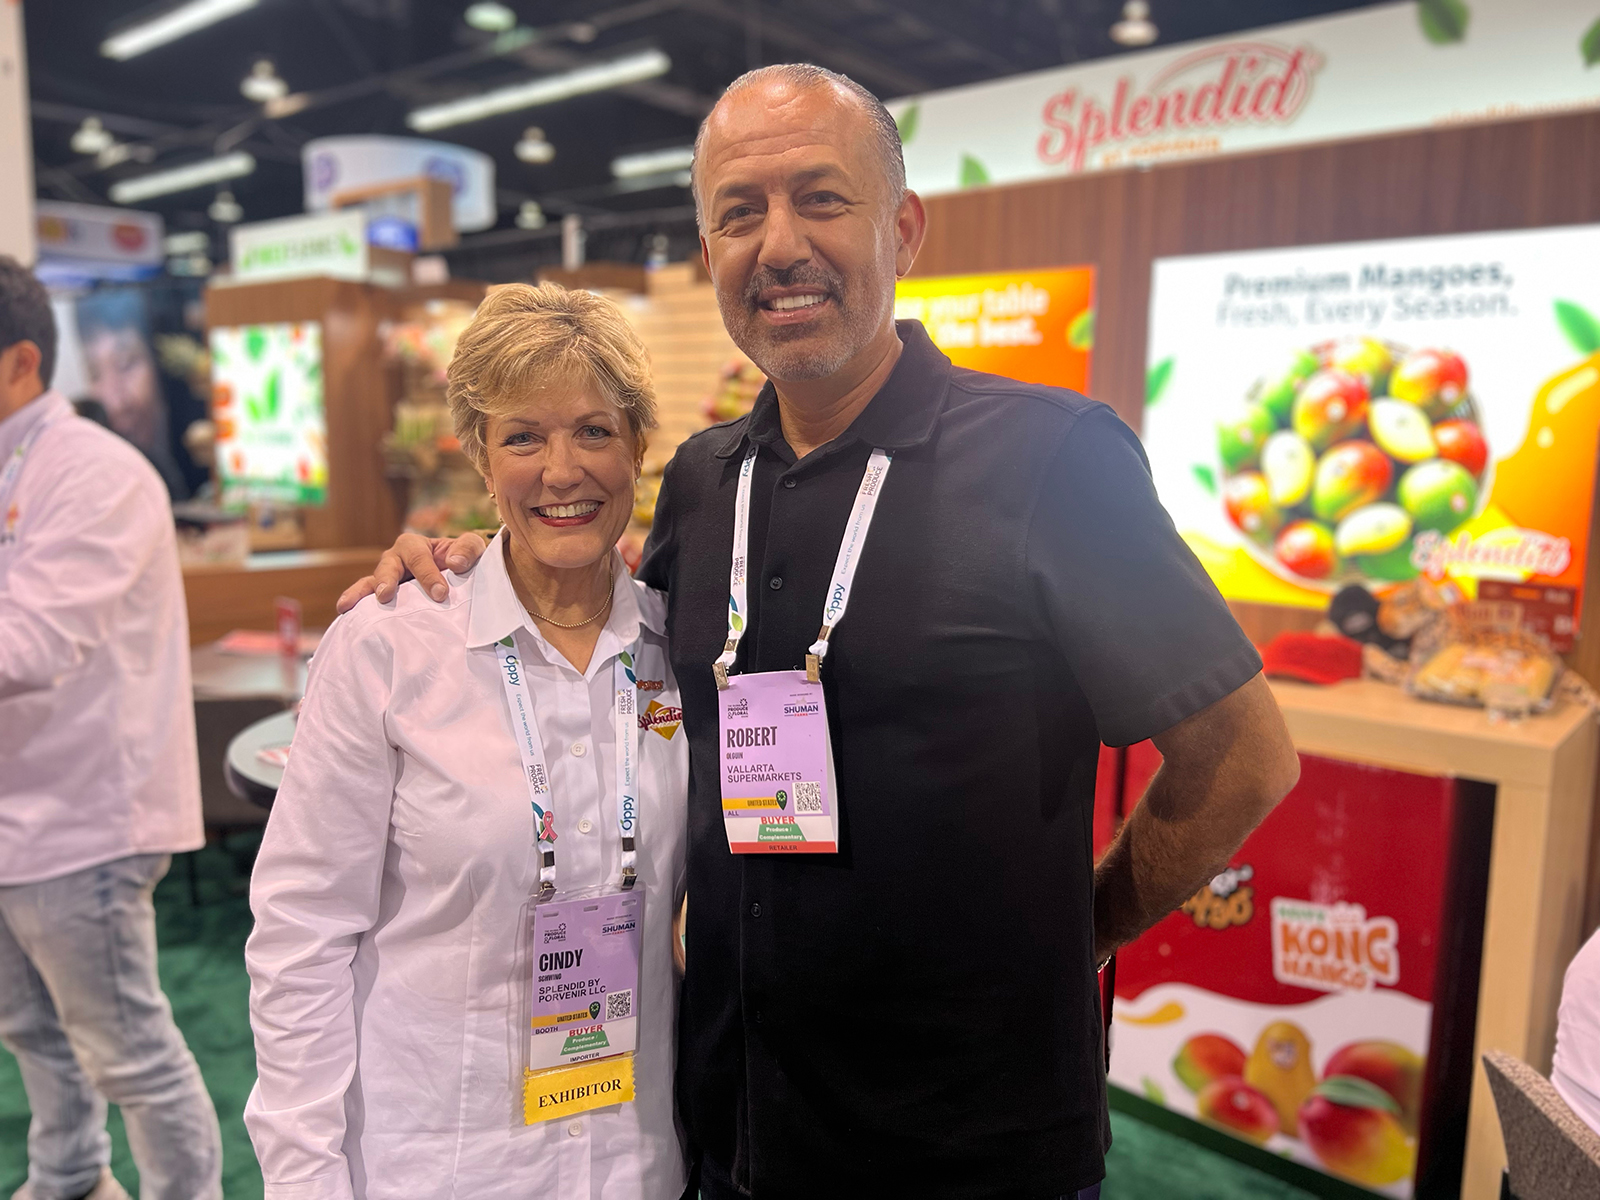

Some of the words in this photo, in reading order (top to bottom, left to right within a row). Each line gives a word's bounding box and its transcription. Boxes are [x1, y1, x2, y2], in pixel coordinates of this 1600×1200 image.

[1037, 45, 1306, 173] Splendid
[1224, 272, 1350, 298] Premium
[1359, 262, 1515, 293] Mangoes,
[928, 294, 981, 321] your
[983, 283, 1050, 316] table
[1304, 296, 1388, 328] Every
[979, 316, 1043, 347] best.
[862, 473, 873, 495] FRESH
[867, 466, 883, 496] PRODUCE
[841, 552, 851, 574] Expect
[1410, 528, 1571, 581] Splendid
[784, 705, 819, 714] SHUMAN
[726, 726, 778, 748] ROBERT
[529, 764, 541, 795] PRODUCE
[535, 764, 545, 785] FRESH
[727, 764, 775, 774] VALLARTA
[727, 772, 802, 783] SUPERMARKETS
[760, 816, 795, 825] BUYER
[602, 922, 636, 934] SHUMAN
[1280, 921, 1390, 976] KONG
[539, 948, 584, 972] CINDY
[1282, 960, 1367, 990] MANGO
[538, 980, 586, 995] SPLENDID
[587, 978, 601, 987] BY
[538, 988, 587, 1003] PORVENIR
[589, 985, 606, 996] LLC
[557, 1014, 573, 1023] UNITED
[572, 1012, 588, 1020] STATES
[535, 1026, 559, 1035] BOOTH
[569, 1024, 603, 1037] BUYER
[572, 1035, 595, 1044] Produce
[563, 1040, 607, 1053] Complementary
[569, 1052, 600, 1063] IMPORTER
[538, 1078, 622, 1109] EXHIBITOR
